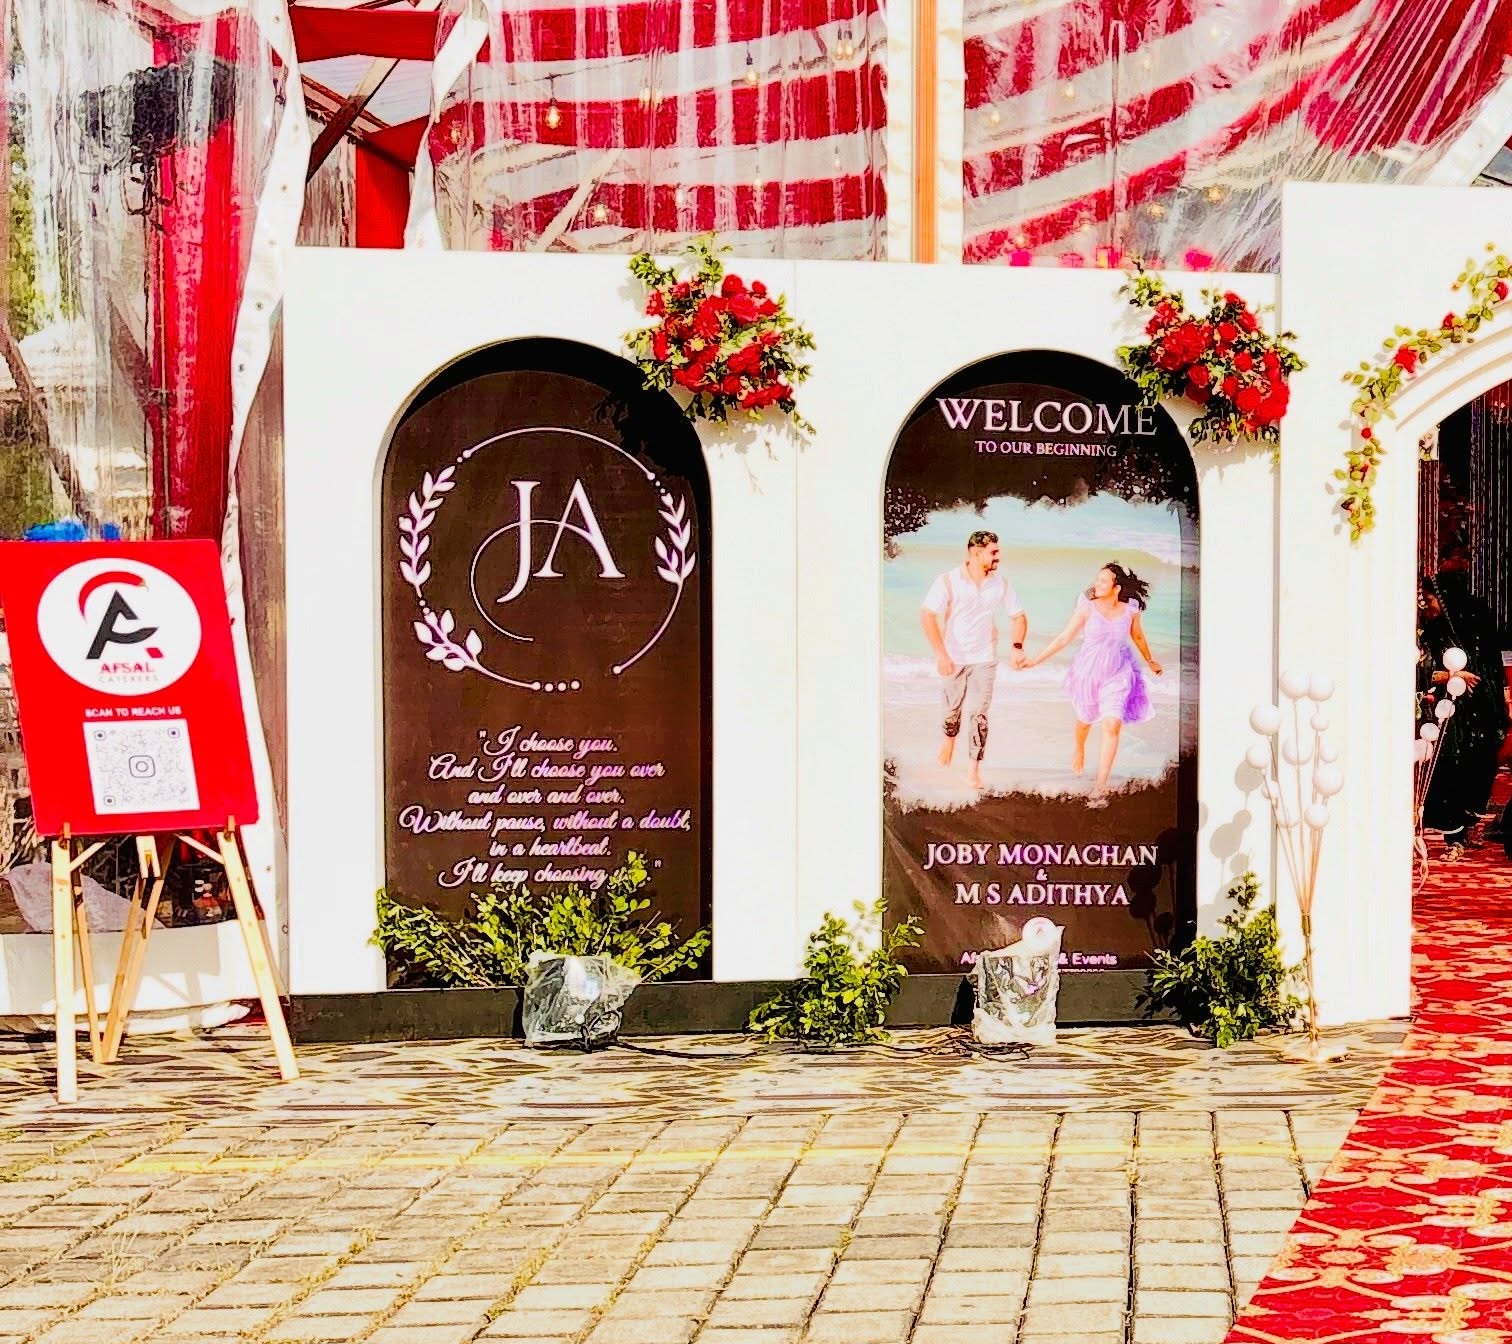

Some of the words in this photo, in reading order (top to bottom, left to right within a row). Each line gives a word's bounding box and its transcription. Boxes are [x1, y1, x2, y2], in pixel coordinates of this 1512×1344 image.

[936, 398, 1158, 436] WELCOME
[974, 440, 998, 455] TO
[1000, 441, 1032, 455] OUR
[1036, 442, 1118, 457] BEGINNING
[100, 661, 156, 674] AFSAL
[85, 708, 113, 718] SCAN
[115, 707, 130, 717] TO
[131, 706, 166, 717] REACH
[167, 705, 182, 716] US
[519, 731, 575, 752] choose
[573, 738, 618, 760] you.
[429, 753, 479, 779] And
[478, 752, 529, 782] I'll
[531, 758, 586, 778] choose
[585, 764, 626, 786] you
[630, 762, 666, 778] over
[468, 784, 506, 804] and
[506, 789, 543, 804] over
[547, 784, 585, 804] and
[586, 788, 625, 804] over.
[399, 805, 493, 834] Without
[490, 816, 546, 838] pause,
[553, 810, 619, 830] without
[621, 816, 635, 829] a
[640, 809, 692, 832] doubt,
[489, 841, 508, 856] in
[512, 843, 527, 856] a
[529, 836, 612, 856] heartbeat.
[923, 843, 993, 869] JOBY
[997, 843, 1159, 867] MONACHAN
[490, 862, 529, 889] keep
[534, 862, 608, 889] choosing
[1035, 868, 1048, 881] &
[954, 883, 981, 905] M
[986, 883, 1001, 905] S
[1006, 883, 1131, 906] ADITHYA
[1057, 953, 1069, 965] &
[1072, 952, 1118, 966] Events
